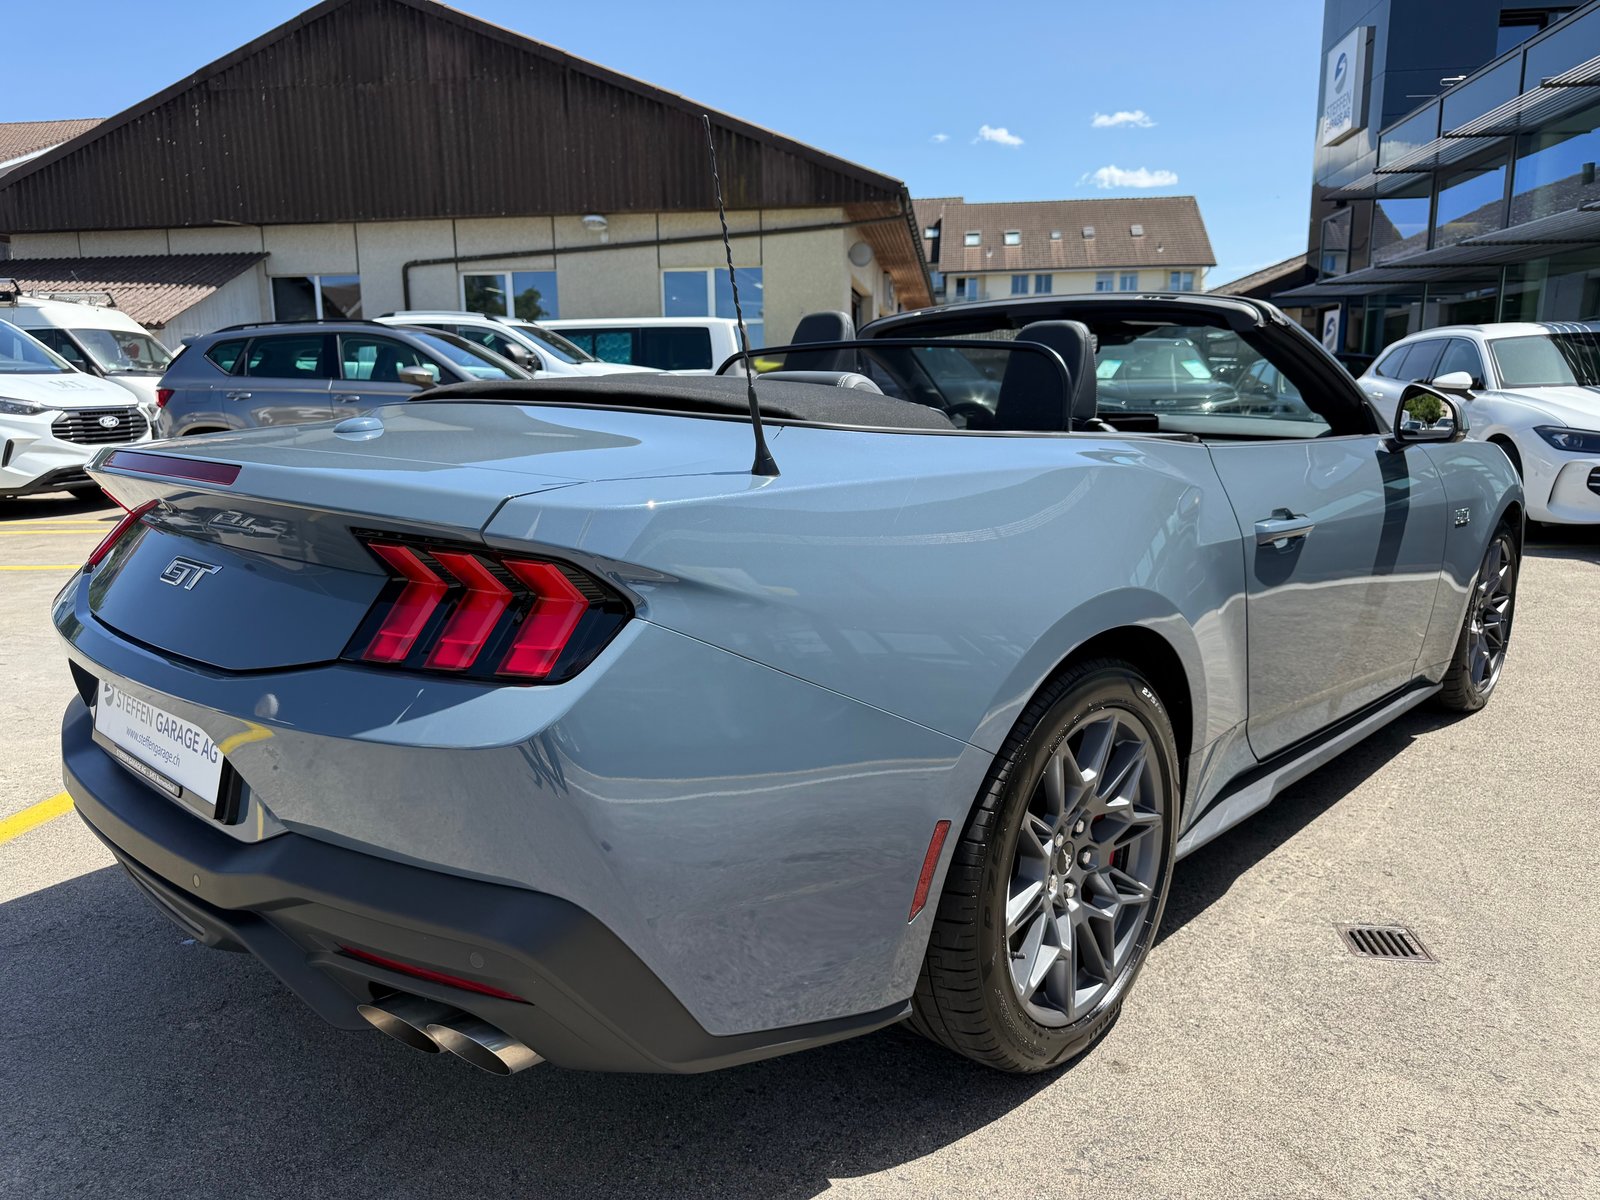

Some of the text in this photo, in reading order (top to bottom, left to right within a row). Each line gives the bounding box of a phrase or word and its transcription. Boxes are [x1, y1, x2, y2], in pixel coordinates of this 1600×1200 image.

[160, 555, 224, 591] GT
[116, 690, 218, 764] STEFFEN GARAGE AG
[126, 726, 181, 767] www.steffengarage.ch
